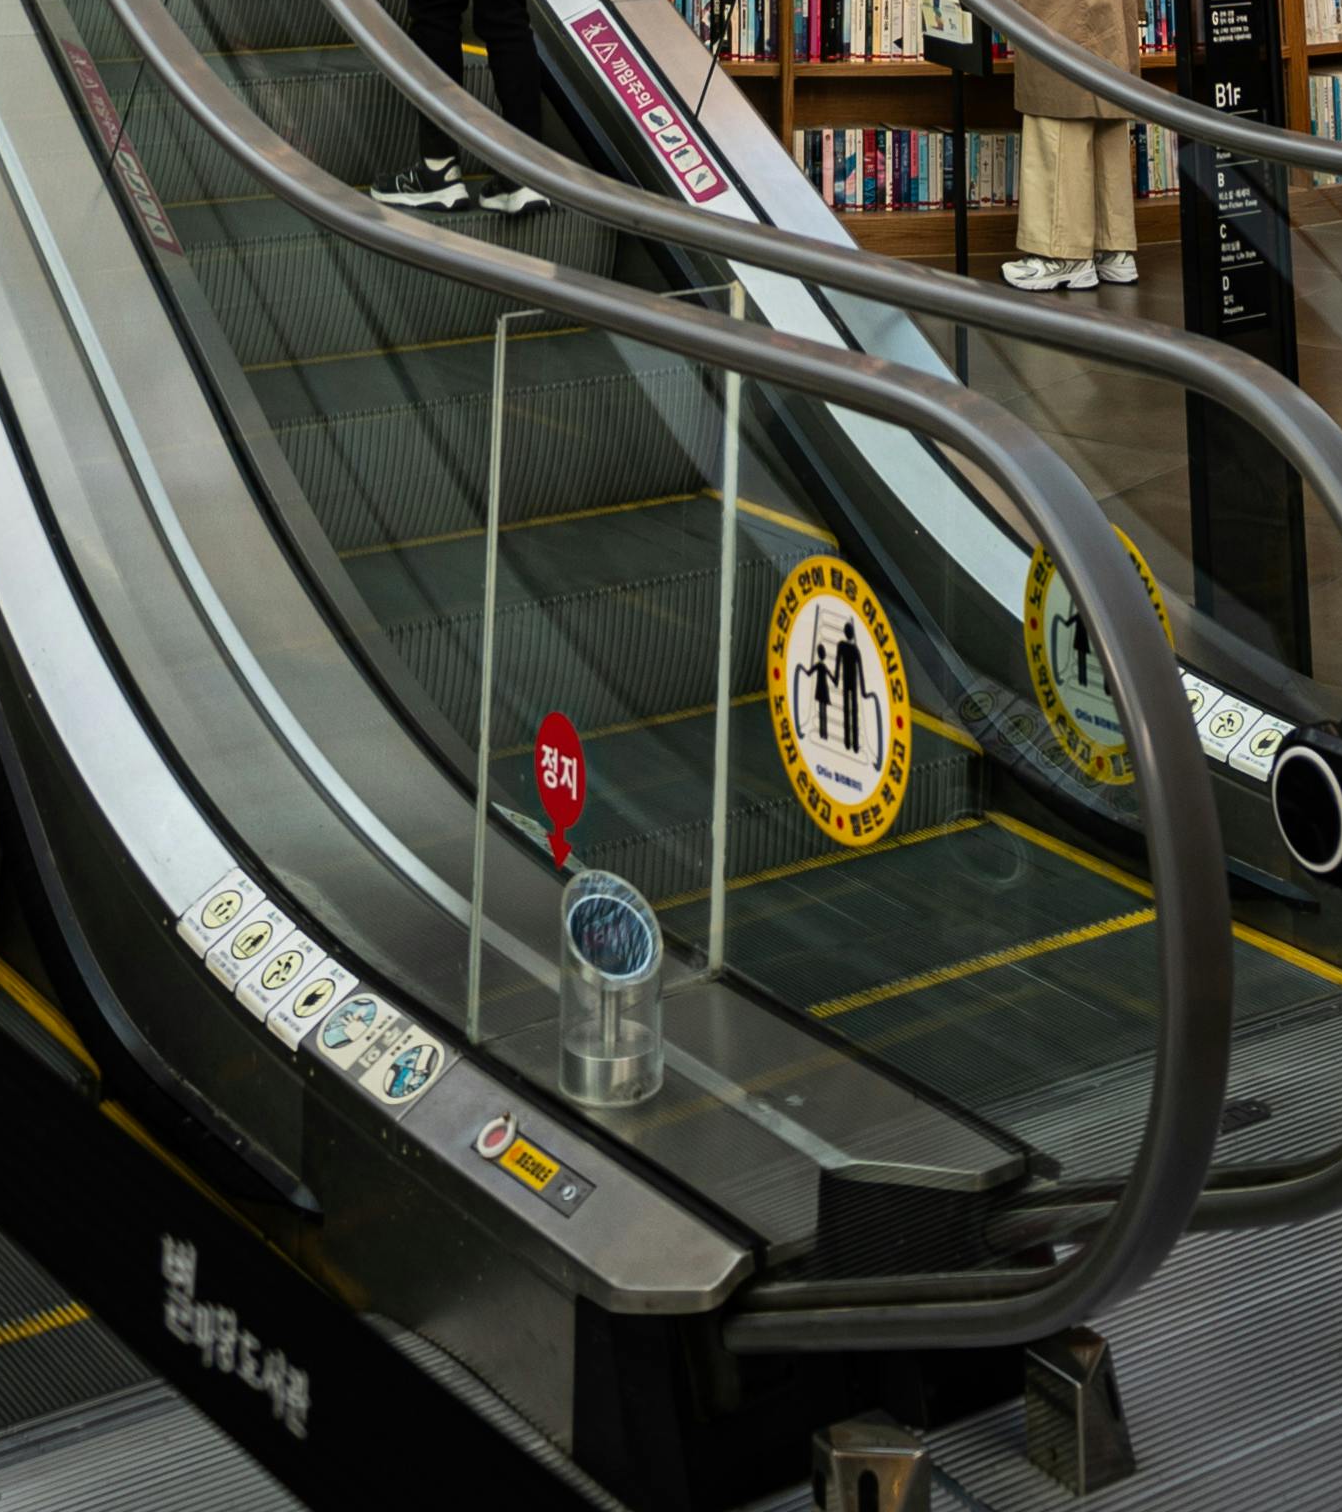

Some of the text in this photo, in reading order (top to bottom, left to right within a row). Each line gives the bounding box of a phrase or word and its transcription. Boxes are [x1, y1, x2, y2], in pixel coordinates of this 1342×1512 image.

[1211, 11, 1219, 26] G
[609, 56, 655, 110] 끼임주의
[1215, 82, 1241, 108] B1F
[1218, 172, 1225, 187] B
[1220, 224, 1227, 238] C
[1222, 276, 1230, 291] D
[798, 564, 826, 594] 안에
[830, 566, 859, 602] 탑승
[862, 596, 905, 704] 하십시오
[539, 743, 580, 802] 정지
